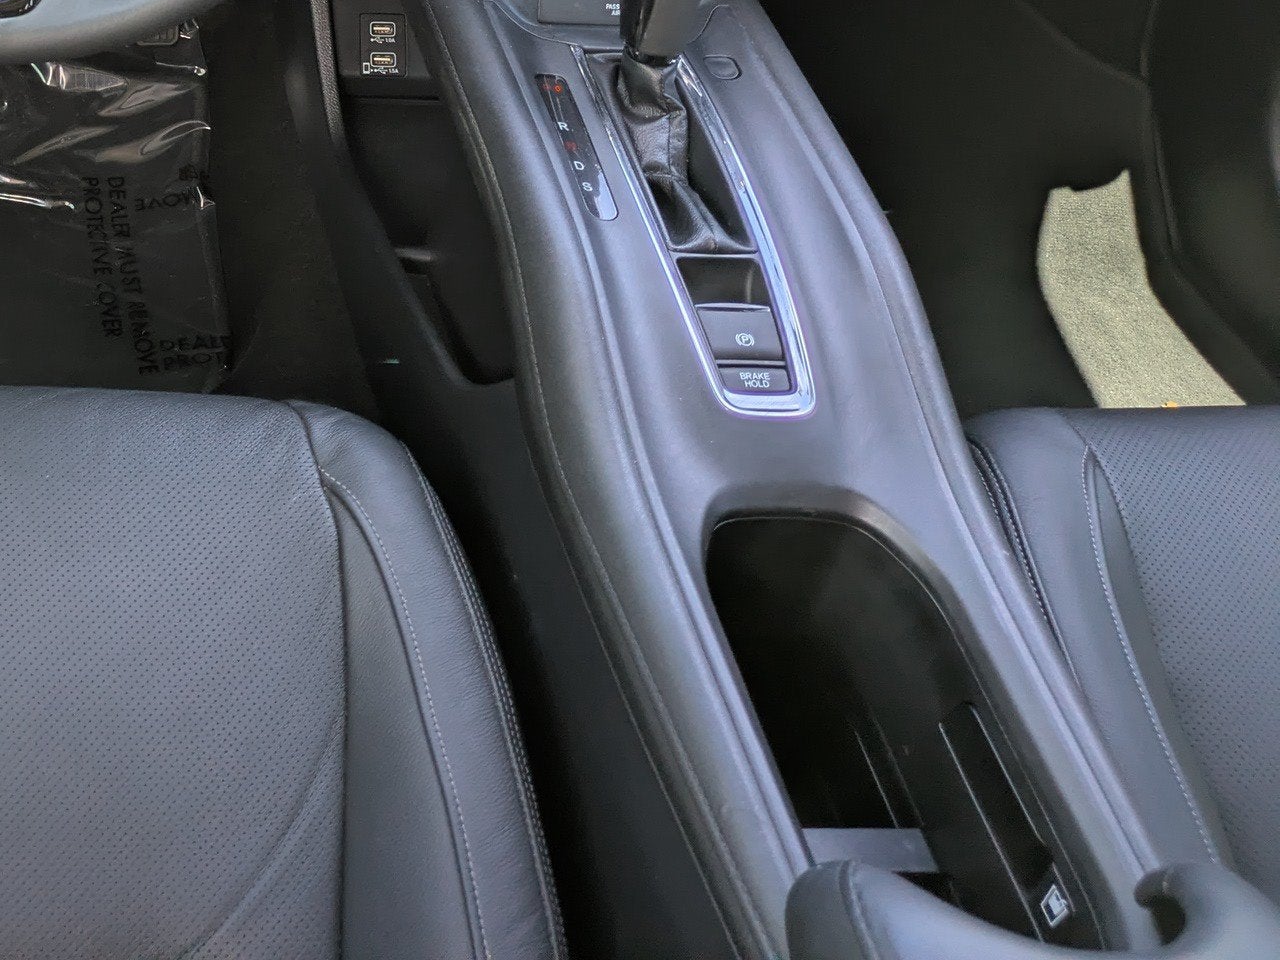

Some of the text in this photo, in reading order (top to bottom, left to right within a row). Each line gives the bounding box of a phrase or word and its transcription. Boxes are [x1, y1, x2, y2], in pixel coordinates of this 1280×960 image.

[557, 121, 570, 132] R
[573, 160, 585, 171] D
[582, 182, 593, 192] S
[739, 372, 770, 381] BRAKE
[744, 380, 770, 388] HOLD
